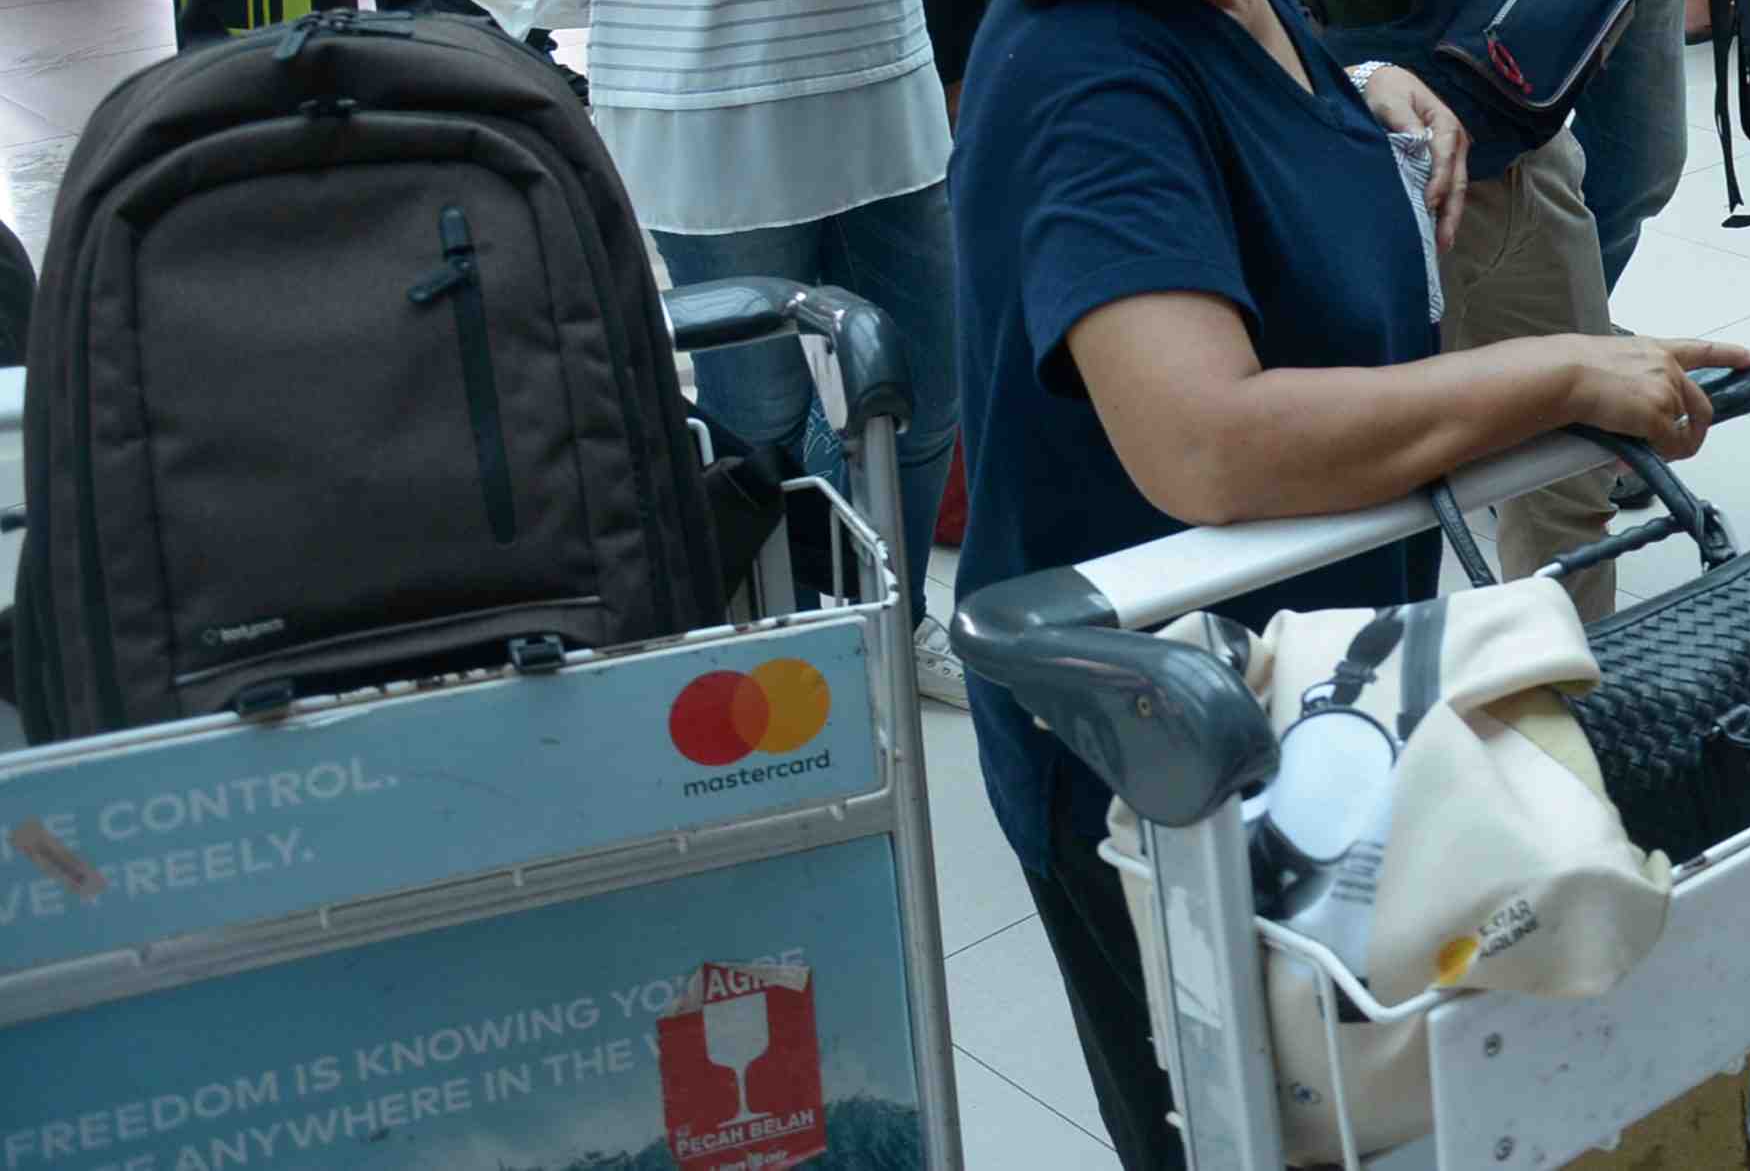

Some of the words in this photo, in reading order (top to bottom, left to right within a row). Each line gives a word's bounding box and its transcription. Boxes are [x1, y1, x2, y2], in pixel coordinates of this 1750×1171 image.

[101, 757, 399, 840] CONTROL.
[683, 748, 831, 797] mastercard
[4, 1070, 280, 1168] FREEDOM
[295, 1055, 342, 1096] IS
[356, 998, 600, 1081] KNOWING
[174, 1078, 473, 1171] ANYWHERE
[482, 1063, 532, 1103] IN
[543, 1037, 635, 1087] THE
[750, 1109, 816, 1137] BELAH
